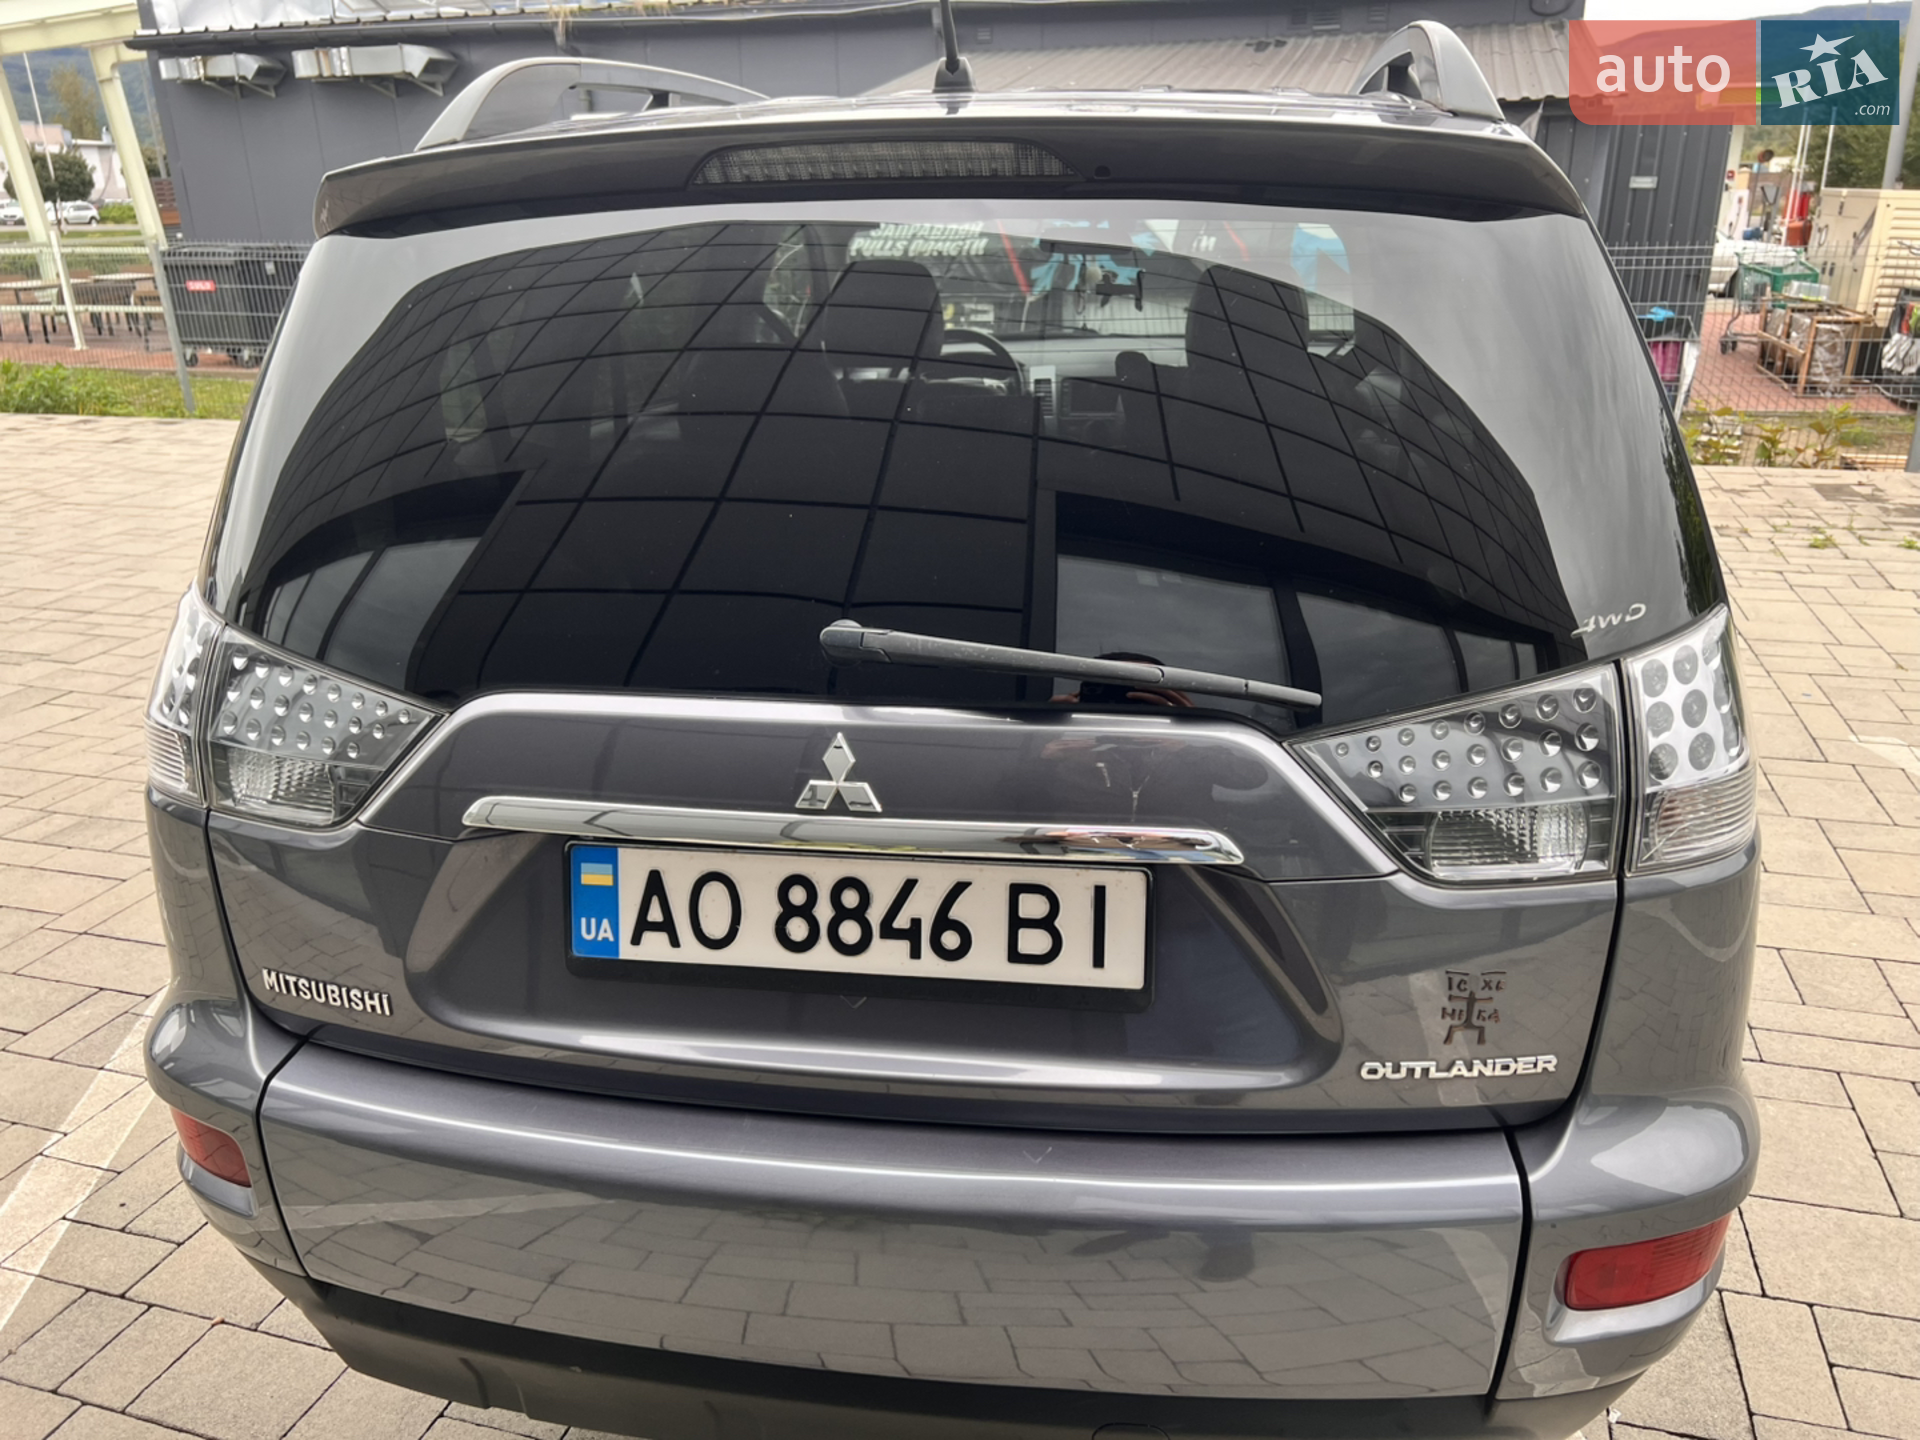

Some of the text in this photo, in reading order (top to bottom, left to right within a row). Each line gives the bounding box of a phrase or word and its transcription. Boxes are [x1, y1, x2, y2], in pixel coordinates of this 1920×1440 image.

[850, 238, 909, 257] PULLS
[580, 916, 615, 942] UA
[629, 868, 1106, 969] AO 8846 BI
[261, 967, 392, 1016] MITSUBISHI
[1360, 1054, 1558, 1080] OUTLANDER
